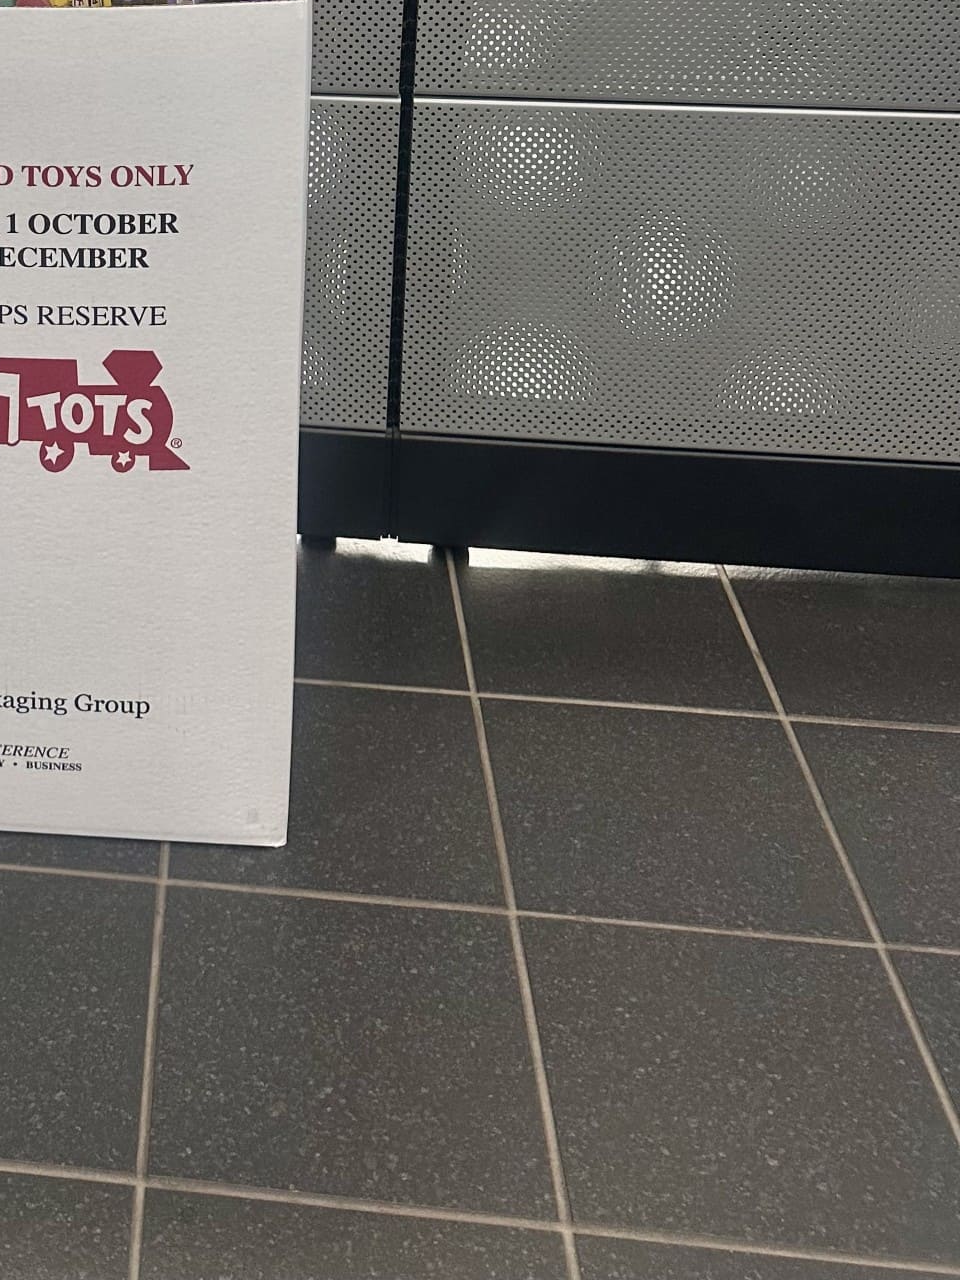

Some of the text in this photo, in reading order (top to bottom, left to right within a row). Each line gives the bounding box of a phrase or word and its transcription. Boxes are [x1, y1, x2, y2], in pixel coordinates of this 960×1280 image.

[21, 165, 102, 188] TOYS
[110, 164, 194, 187] ONLY
[6, 213, 19, 235] 1
[28, 213, 180, 235] OCTOBER
[37, 306, 167, 326] RESERVE
[26, 392, 155, 445] TOTS
[74, 694, 151, 719] Group
[26, 760, 82, 772] BUSINESS
